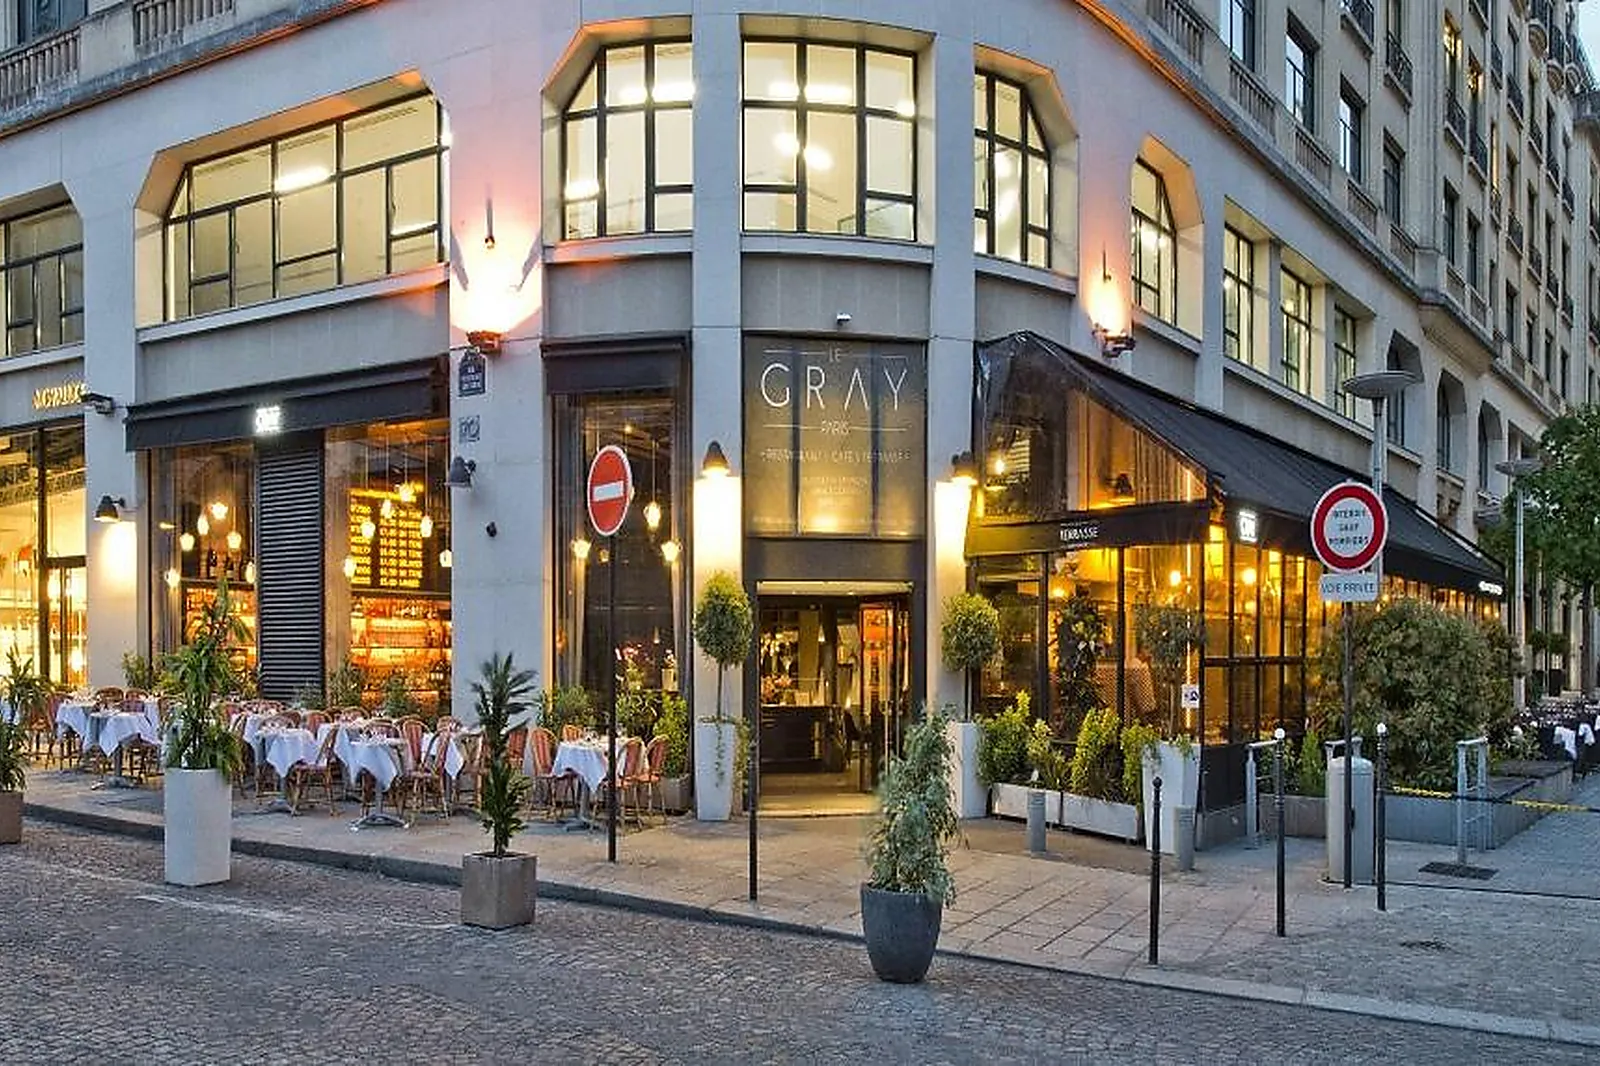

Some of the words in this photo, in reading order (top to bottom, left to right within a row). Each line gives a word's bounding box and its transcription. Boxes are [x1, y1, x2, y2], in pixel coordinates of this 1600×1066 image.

[829, 348, 842, 362] LE
[760, 362, 908, 411] GRAY
[1322, 582, 1341, 593] VOIE
